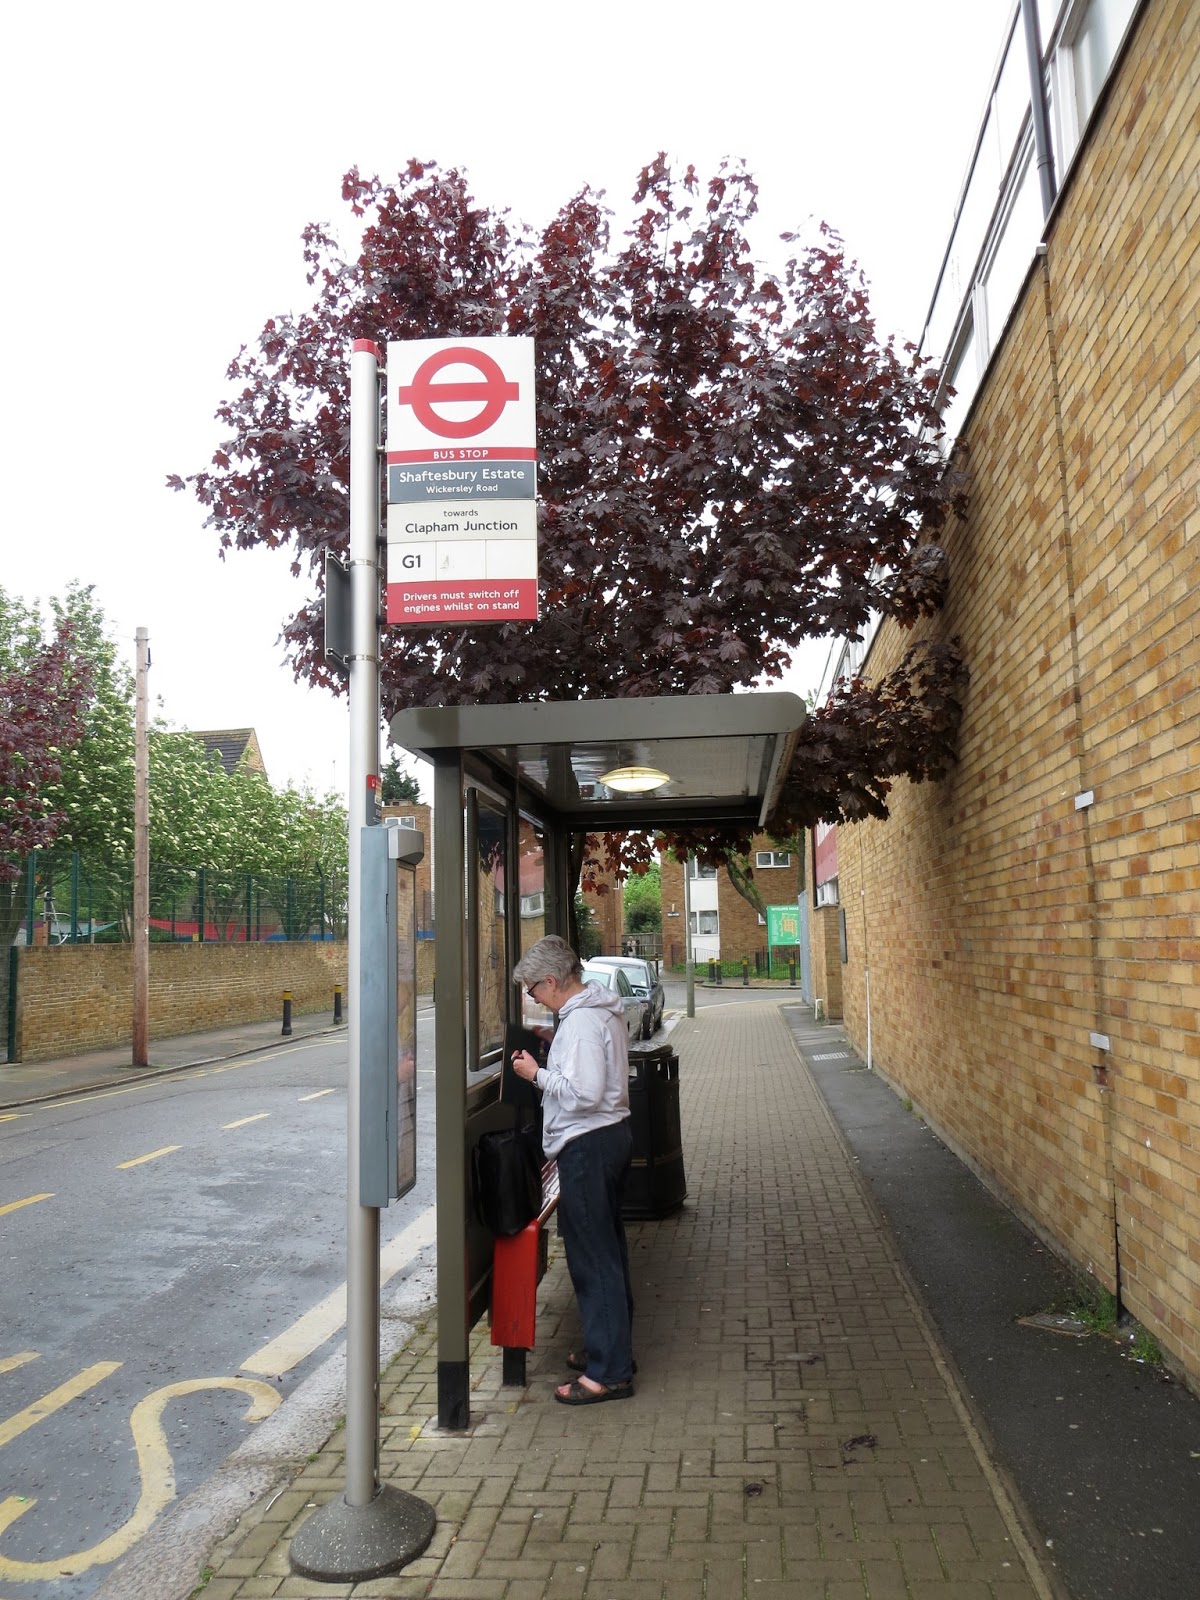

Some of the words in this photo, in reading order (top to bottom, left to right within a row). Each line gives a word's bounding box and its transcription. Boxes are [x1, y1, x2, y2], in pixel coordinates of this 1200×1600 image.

[433, 451, 455, 459] BUS
[460, 449, 489, 458] STOP
[400, 469, 477, 483] Shaftesbury
[482, 468, 525, 480] Estate
[426, 485, 473, 494] Wickersley
[476, 484, 499, 492] Road
[443, 509, 479, 517] towards
[405, 522, 459, 535] Clapham
[463, 520, 518, 531] Junction
[402, 554, 422, 569] G1
[403, 592, 438, 602] Drivers
[440, 591, 465, 600] must
[468, 589, 501, 599] switch
[503, 589, 520, 598] off
[404, 603, 441, 614] engines
[444, 602, 474, 611] whilst
[477, 602, 489, 610] on
[492, 601, 520, 610] stand
